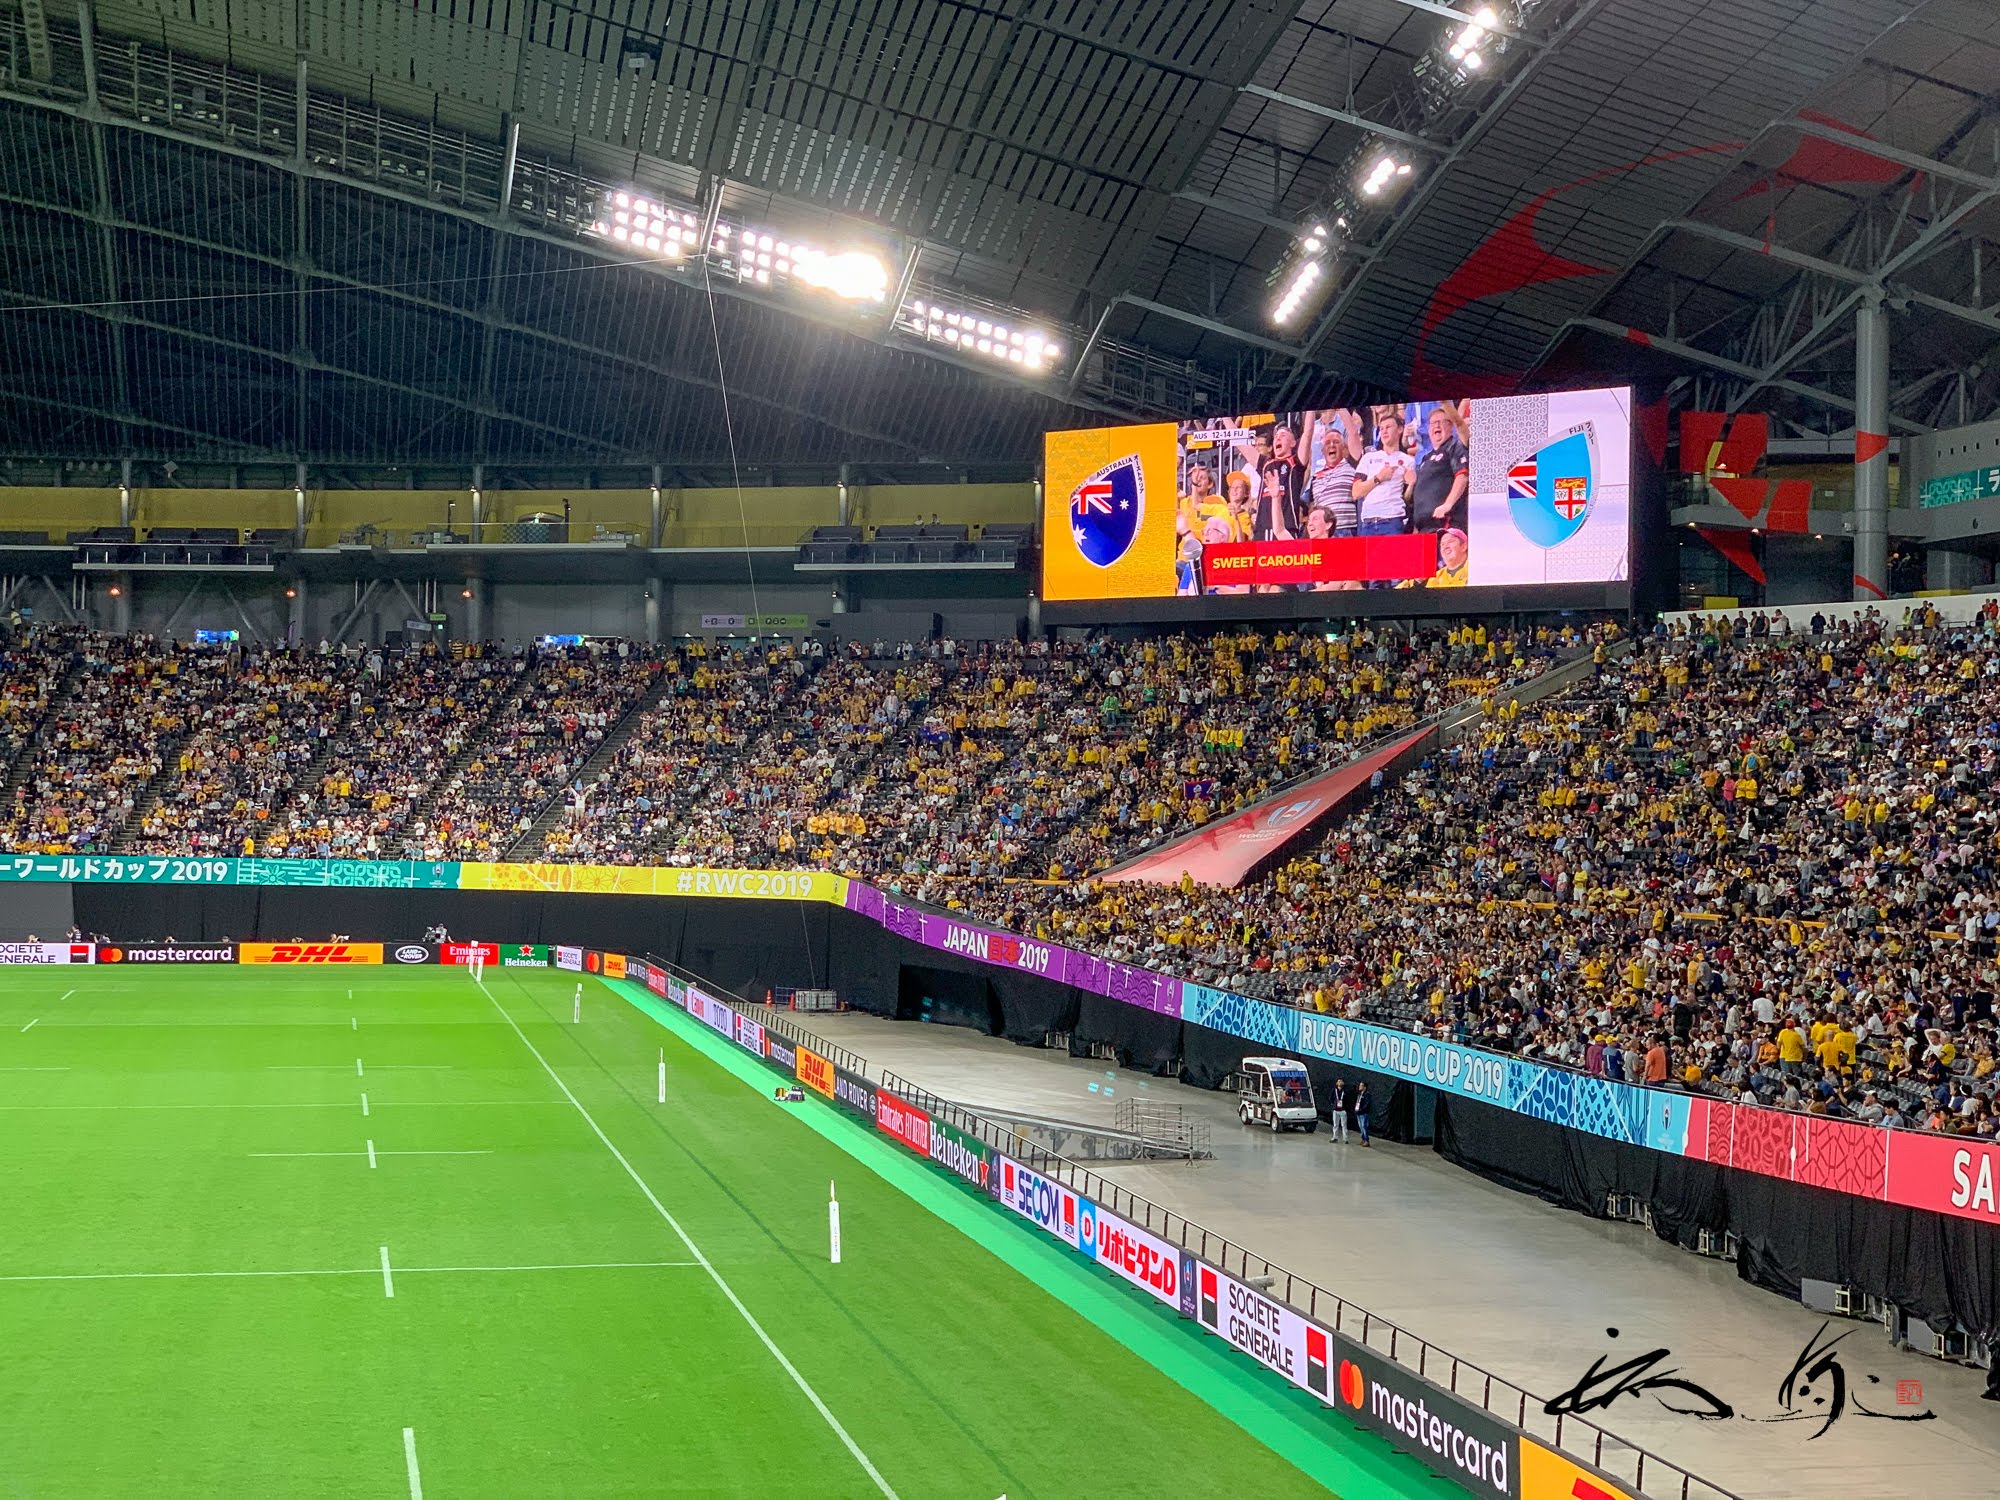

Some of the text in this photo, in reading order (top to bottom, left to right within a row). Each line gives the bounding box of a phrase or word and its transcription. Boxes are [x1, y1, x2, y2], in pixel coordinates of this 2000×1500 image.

[1194, 429, 1244, 440] AUS 12-14 FIJ
[1569, 424, 1584, 435] FIJI
[1096, 457, 1133, 478] AUSTRALIA
[1212, 553, 1322, 569] SWEET CAROLINE
[676, 871, 813, 897] #RWC2019
[270, 945, 353, 963] DHL
[505, 957, 548, 967] Heineken
[943, 924, 1049, 973] JAPAN 日本 2019
[803, 1053, 826, 1090] DHL
[1301, 1017, 1503, 1100] RUGBY WORLD CUP 2019
[834, 1073, 868, 1112] LAND ROVER
[878, 1096, 904, 1136] Emirates
[930, 1119, 980, 1185] Heineken
[1018, 1169, 1060, 1232] SECOM
[1950, 1148, 2000, 1216] SA
[1084, 1216, 1092, 1238] D
[1099, 1221, 1176, 1297] リポビタンD
[1229, 1283, 1281, 1336] SOCIETE
[1229, 1316, 1294, 1377] GENERALE
